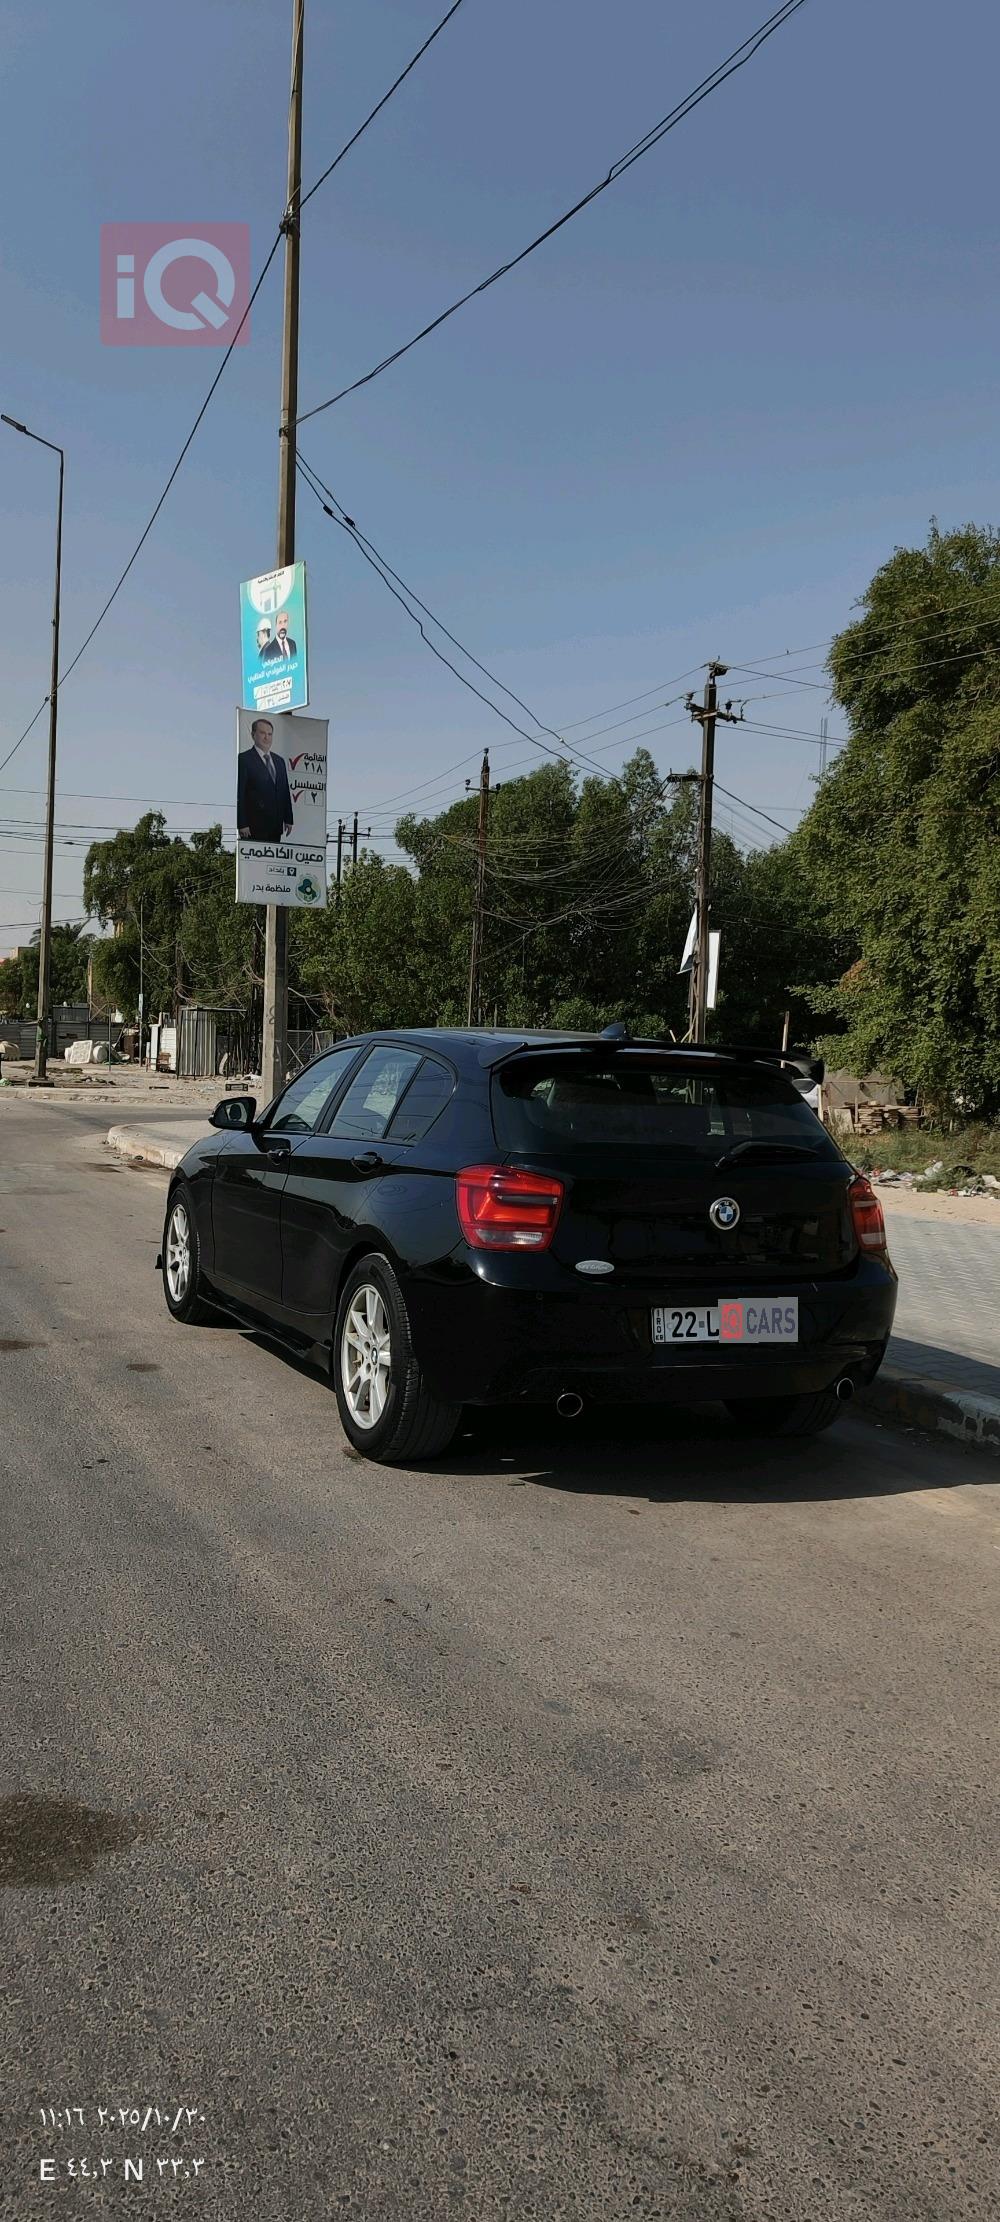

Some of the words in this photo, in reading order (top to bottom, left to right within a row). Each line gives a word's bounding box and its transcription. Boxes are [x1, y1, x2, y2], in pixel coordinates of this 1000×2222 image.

[304, 752, 326, 762] القائمة
[304, 761, 323, 774] ٢١٨
[290, 779, 326, 791] التسلسل
[311, 791, 317, 804] ٢
[240, 846, 293, 860] الكاظمي
[295, 852, 324, 865] معين
[252, 884, 264, 893] بدر
[265, 884, 291, 893] منظمة
